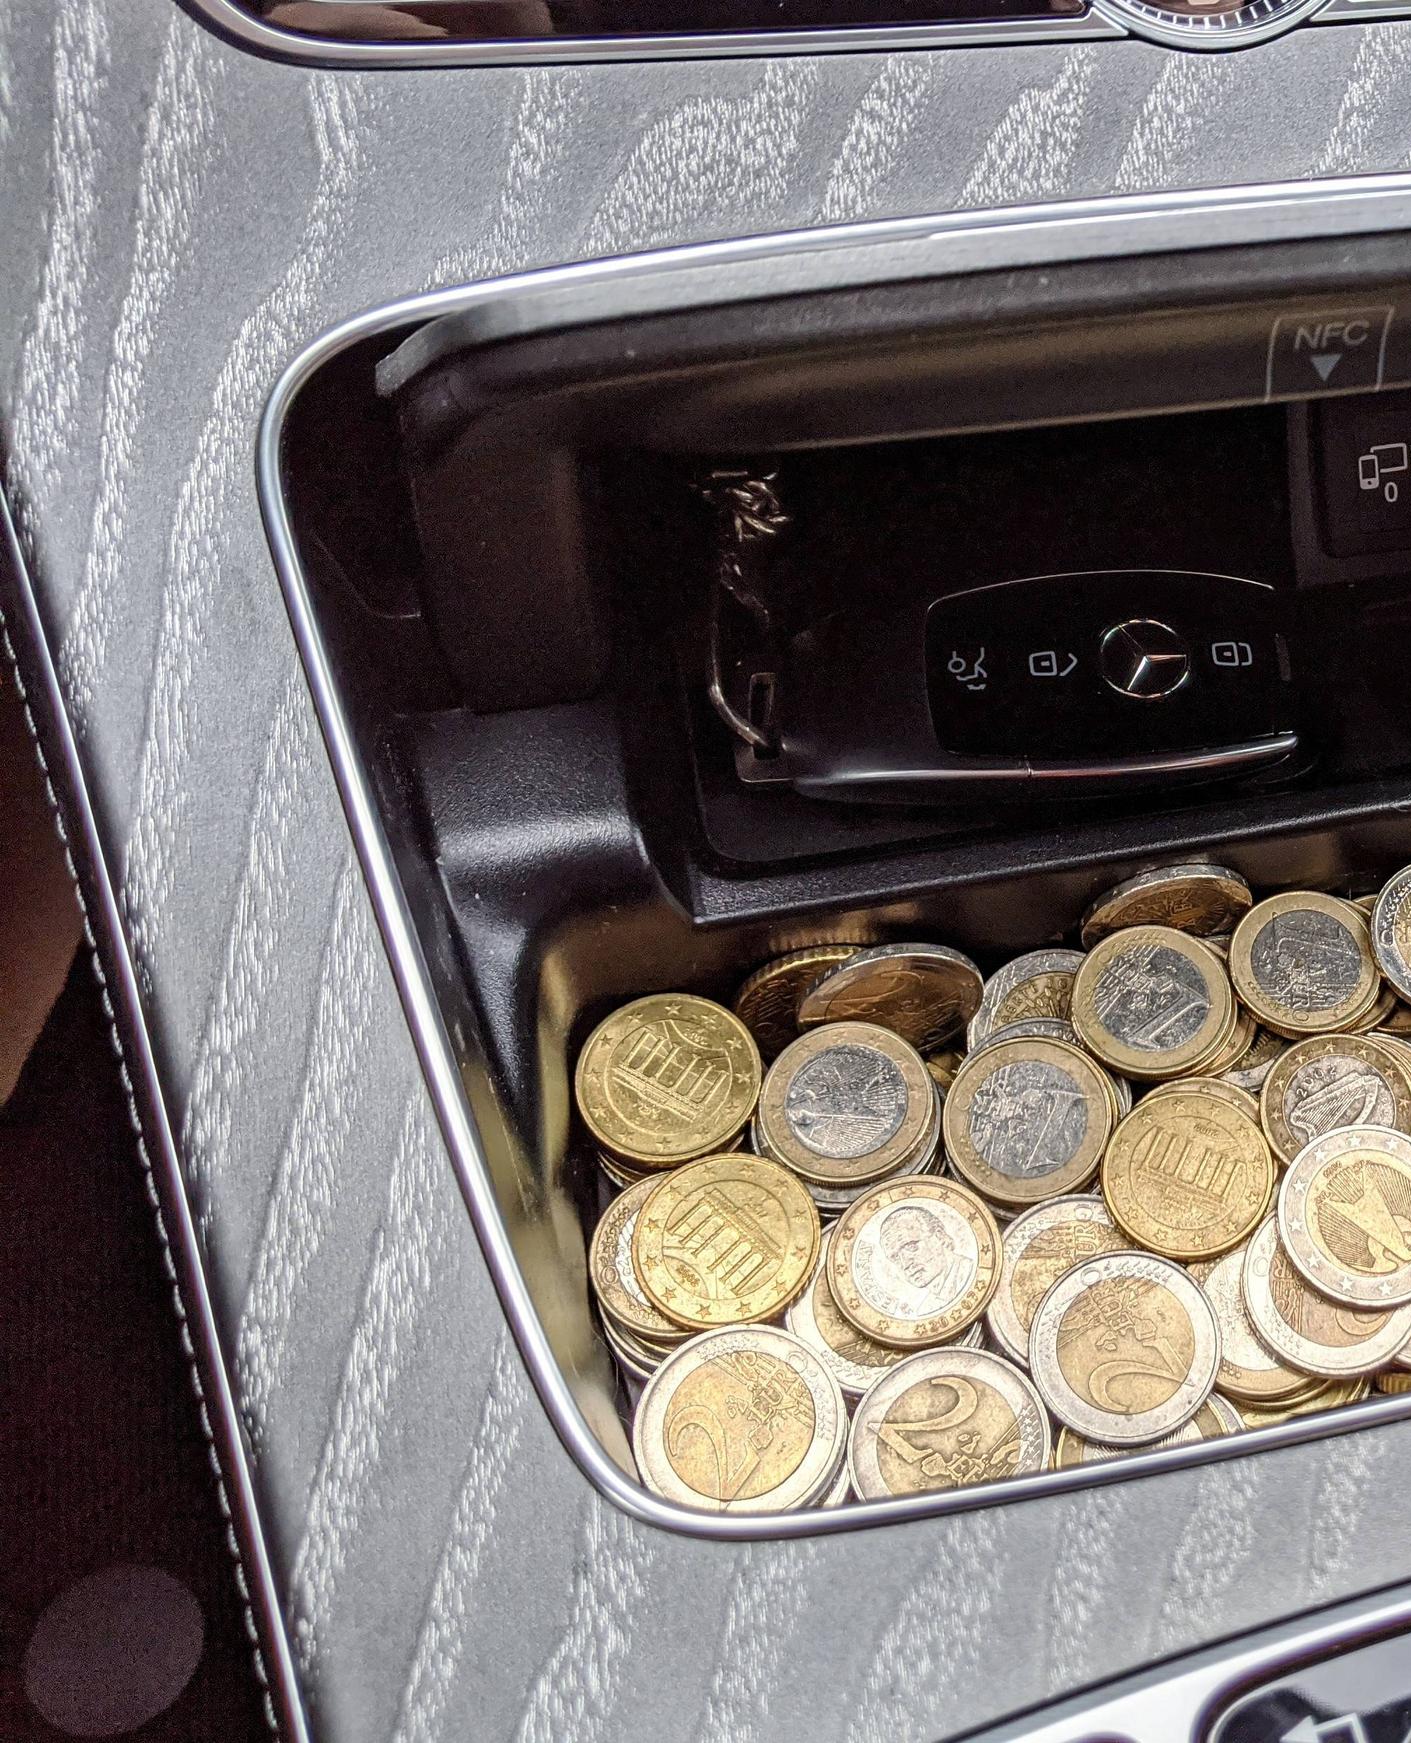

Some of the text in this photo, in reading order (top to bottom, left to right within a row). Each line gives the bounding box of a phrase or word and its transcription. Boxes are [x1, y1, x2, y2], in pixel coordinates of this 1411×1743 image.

[1294, 320, 1371, 350] NFC
[1295, 1064, 1336, 1098] 2002
[1087, 1336, 1194, 1413] 2
[664, 1403, 761, 1510] 2
[866, 1378, 980, 1463] 2
